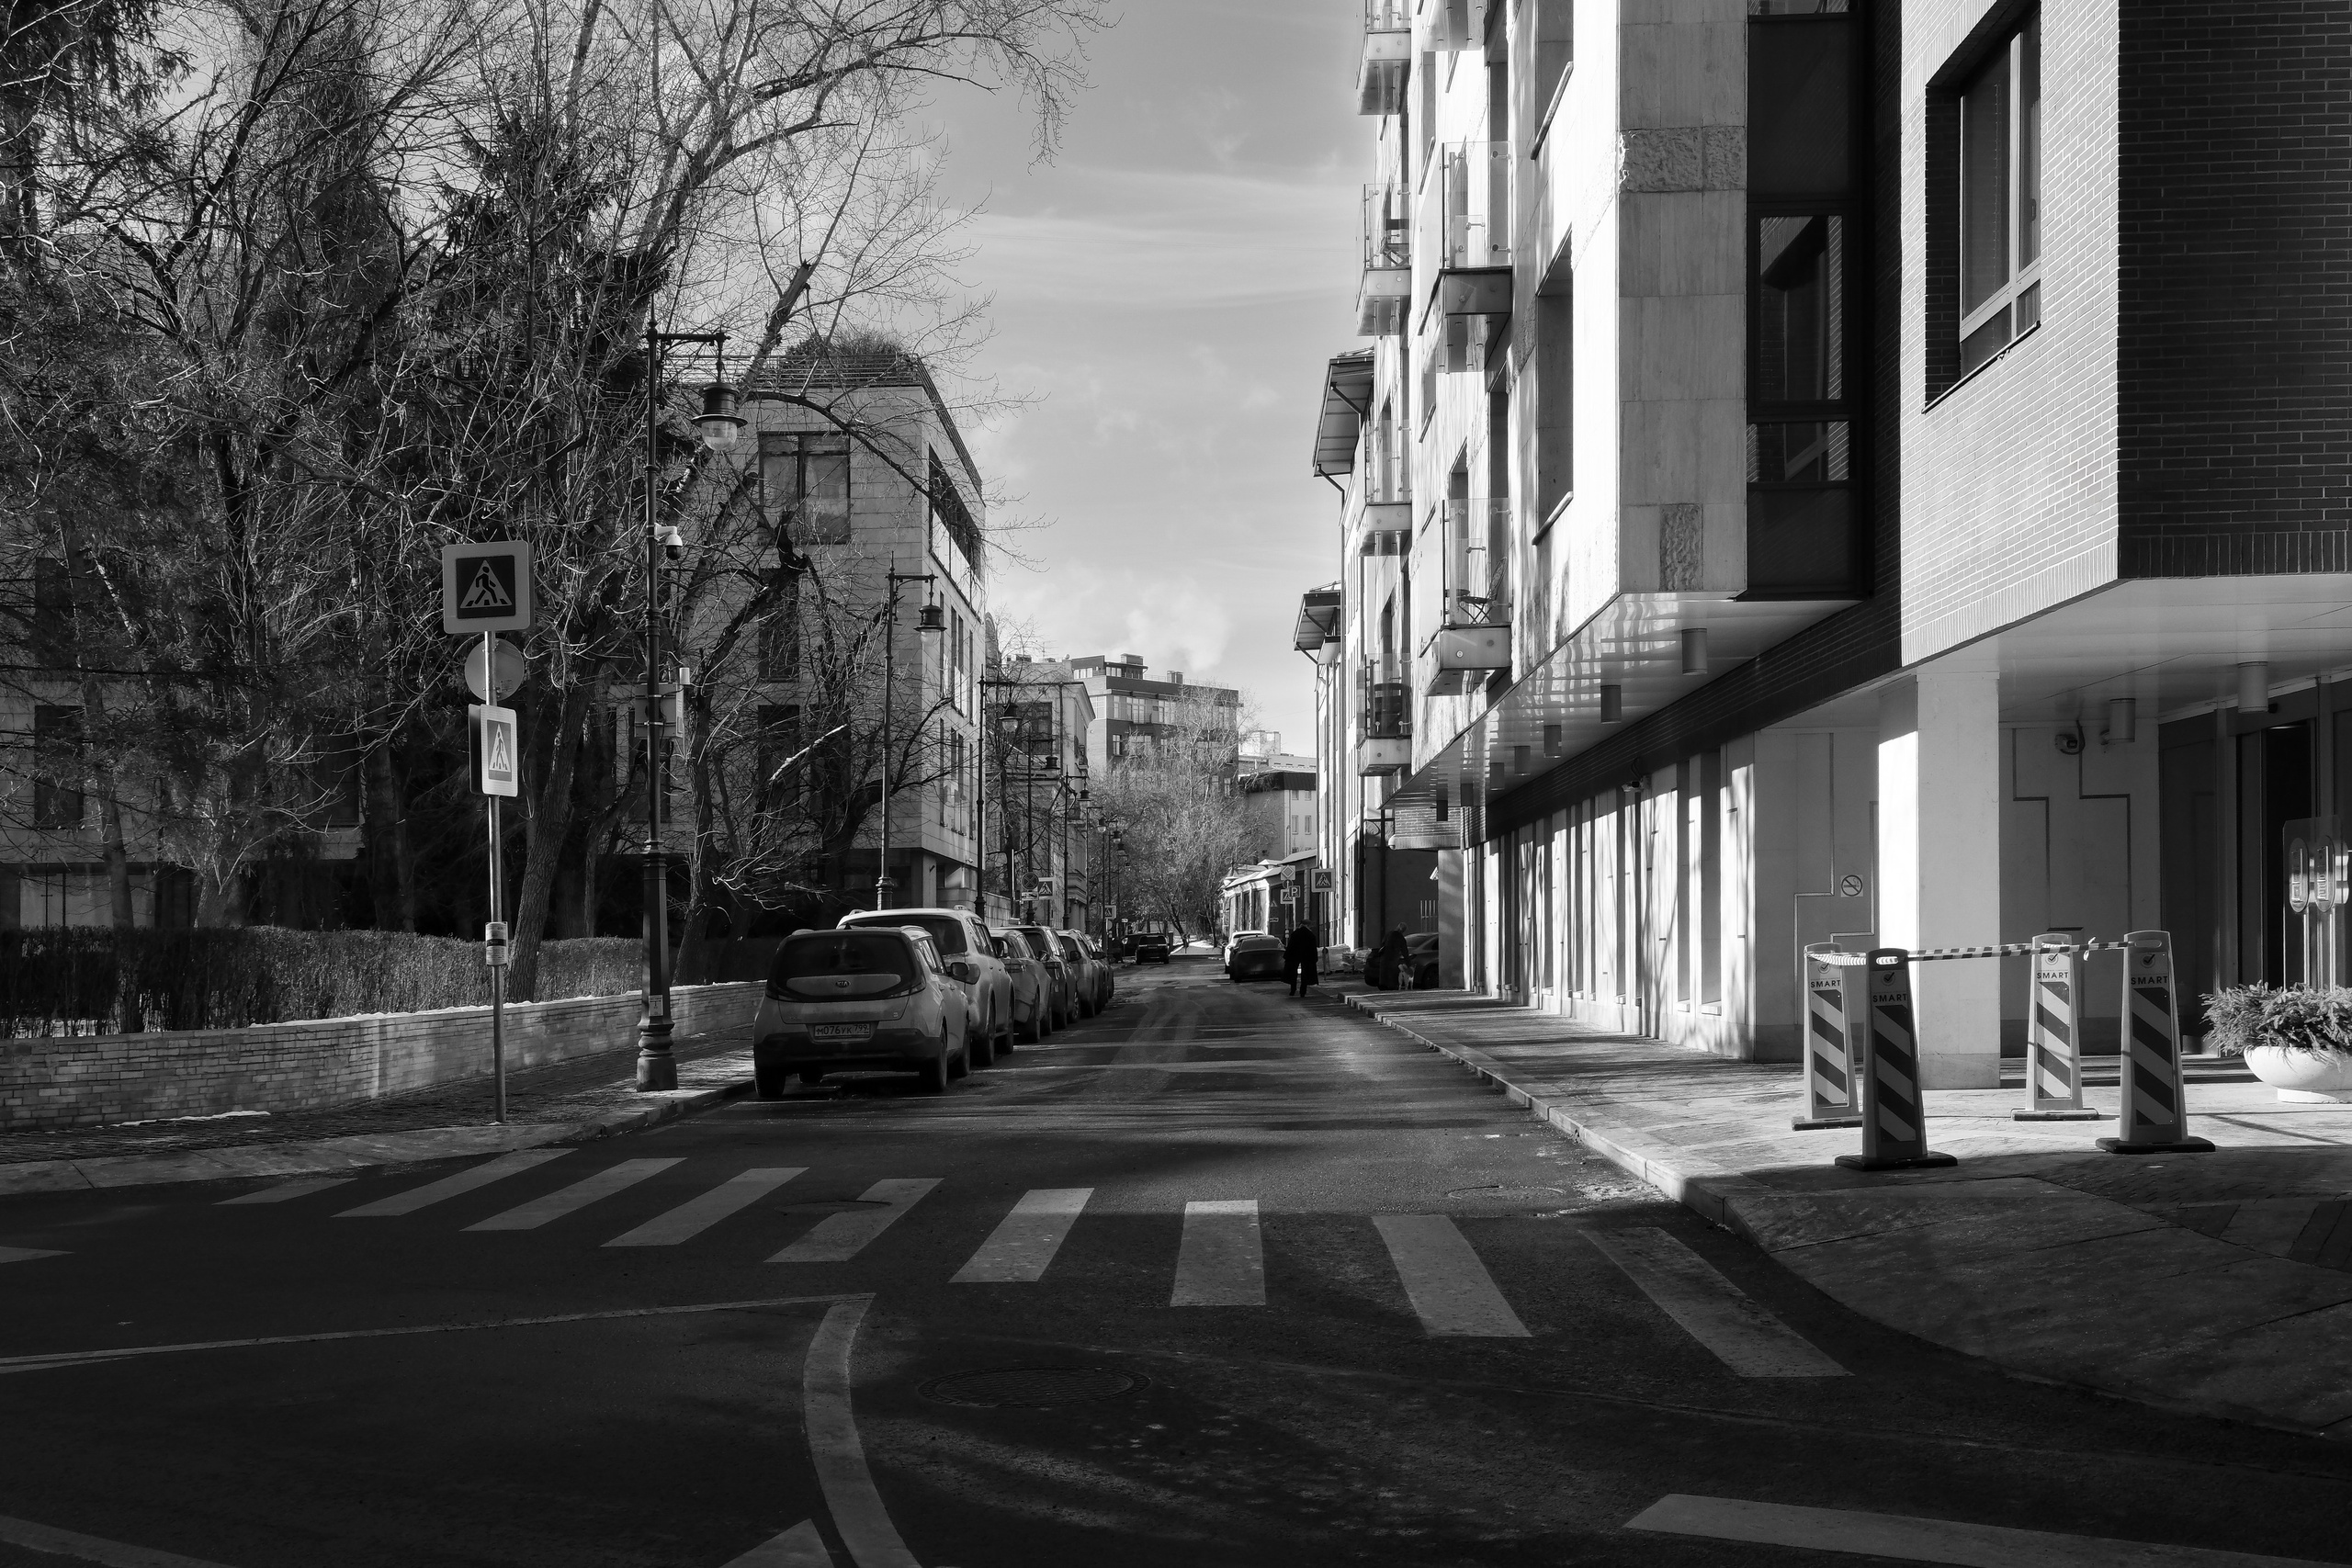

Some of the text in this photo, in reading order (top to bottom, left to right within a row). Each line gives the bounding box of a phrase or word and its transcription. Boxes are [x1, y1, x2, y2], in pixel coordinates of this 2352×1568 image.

[1292, 886, 1298, 897] P
[2036, 971, 2069, 979] SMART
[1810, 979, 1841, 988] SMART
[2131, 976, 2168, 985] SMART
[1872, 993, 1907, 1003] SMART
